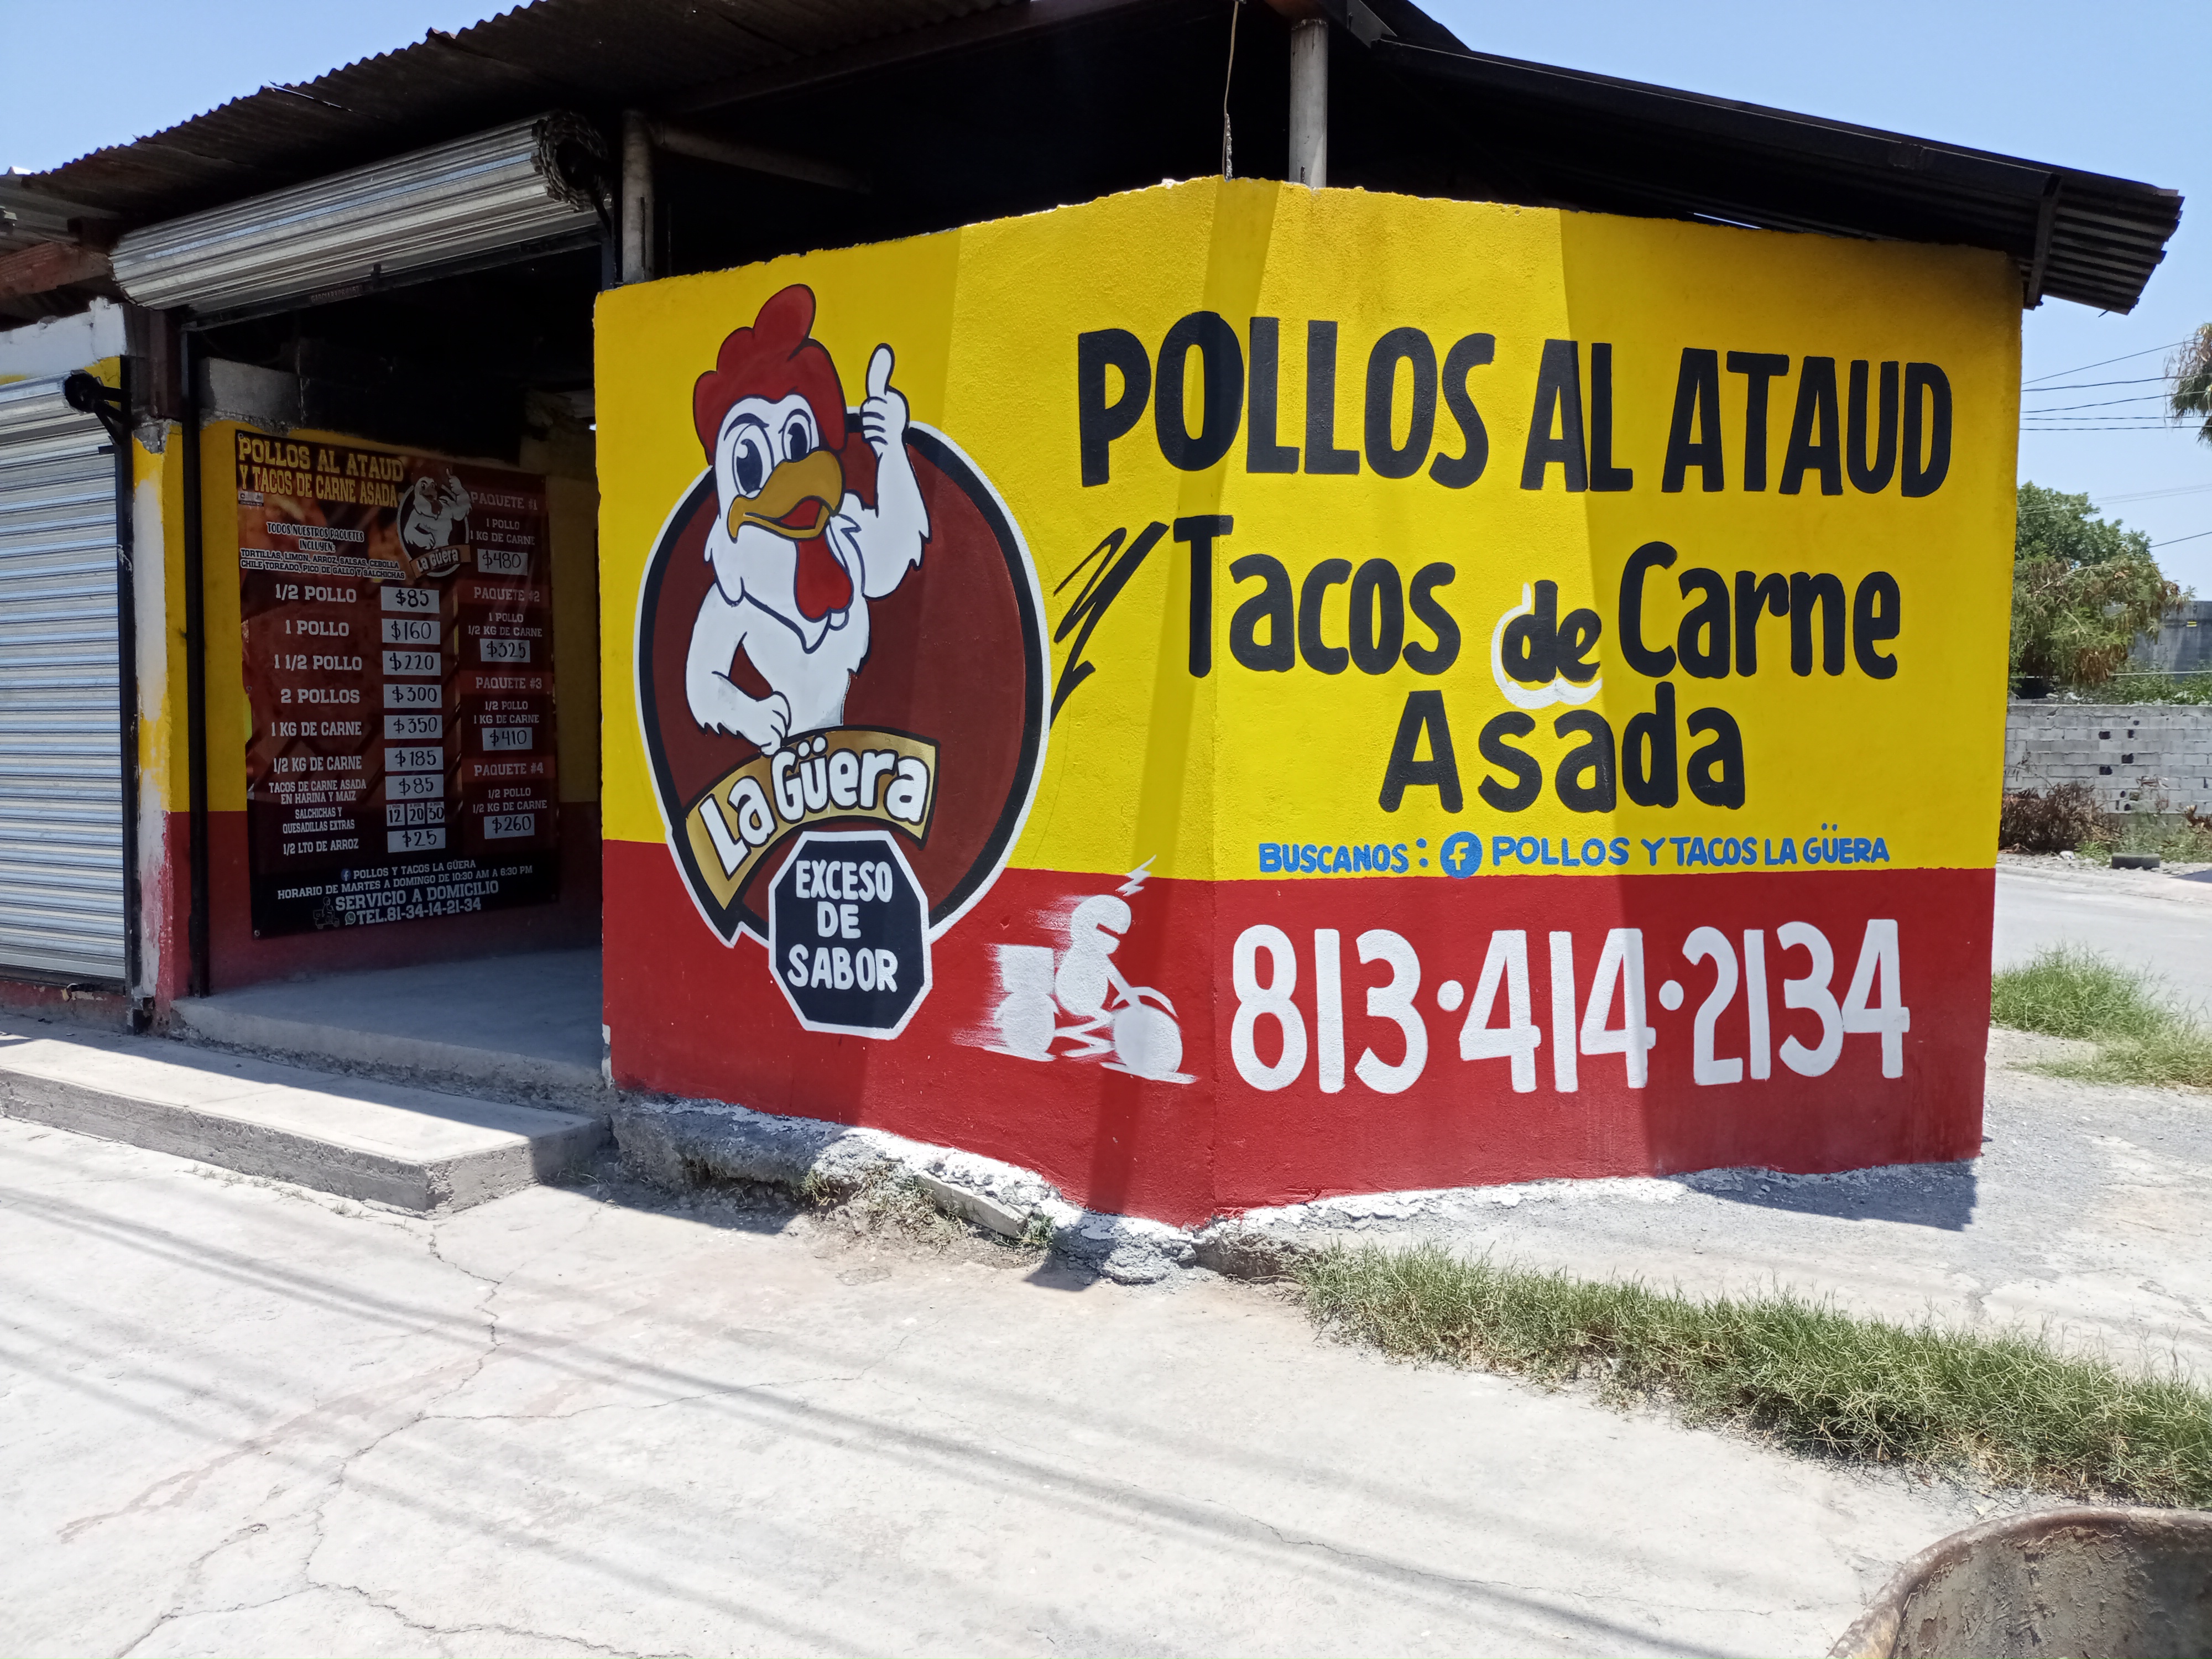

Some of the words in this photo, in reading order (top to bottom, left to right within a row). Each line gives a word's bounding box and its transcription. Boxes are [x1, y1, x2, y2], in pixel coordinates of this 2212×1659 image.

[1078, 310, 1495, 489] POLLOS
[1520, 338, 1633, 493] AL
[1662, 347, 1952, 498] ATAUD
[238, 437, 310, 469] POLLOS
[317, 449, 340, 473] AL
[346, 453, 404, 481] ATAUD
[239, 465, 248, 490] Y
[252, 466, 292, 495] TACOS
[296, 472, 312, 498] DE
[316, 475, 356, 503] CARNE
[359, 481, 398, 508] ASADA
[471, 492, 524, 509] PAQUETE
[528, 498, 538, 510] #1
[267, 523, 291, 534] TODOS
[293, 525, 330, 539] NUESTROS
[330, 528, 364, 542] PAQUETES
[486, 518, 489, 527] 1
[492, 518, 519, 530] POLLO
[300, 540, 335, 552] INCLUYEN:
[471, 530, 473, 539] 1
[476, 531, 488, 541] KG
[492, 533, 503, 542] DE
[506, 534, 535, 545] CARNE
[369, 560, 399, 569] CEBOLLA
[482, 550, 521, 570] $480
[241, 560, 263, 568] CHILE
[363, 569, 405, 580] SALCHICHAS
[276, 584, 298, 601] 1/2
[305, 586, 357, 603] POLLO
[396, 589, 429, 608] $85
[474, 587, 524, 601] PAQUETE
[529, 591, 540, 602] #2
[1173, 514, 1461, 678] Tacos
[1501, 580, 1602, 684] de
[1619, 541, 1901, 680] Carne
[489, 613, 492, 622] 1
[495, 613, 524, 623] POLLO
[286, 619, 291, 634] 1
[297, 620, 349, 637] POLLO
[392, 620, 431, 640] $160
[468, 625, 480, 635] 1/2
[484, 626, 497, 635] KG
[500, 627, 510, 635] DE
[513, 627, 542, 637] CARNE
[487, 640, 525, 658] $325
[274, 654, 280, 669] 1
[285, 655, 307, 671] 1/2
[313, 655, 362, 671] POLLO
[389, 653, 434, 671] $220
[476, 677, 525, 688] PAQUETE
[530, 677, 542, 689] #3
[281, 688, 291, 703] 2
[298, 688, 360, 703] POLLOS
[392, 686, 437, 702] $300
[485, 701, 498, 711] 1/2
[502, 701, 528, 710] POLLO
[394, 717, 437, 734] $350
[474, 715, 476, 724] 1
[479, 715, 493, 724] KG
[496, 714, 507, 724] DE
[509, 714, 539, 723] CARNE
[272, 722, 276, 737] 1
[280, 722, 297, 737] KG
[301, 722, 317, 736] DE
[321, 721, 362, 735] CARNE
[489, 729, 526, 746] $410
[1379, 681, 1745, 813] Asada
[274, 758, 288, 774] 1/2
[292, 757, 306, 771] KG
[310, 757, 324, 771] DE
[327, 756, 362, 770] CARNE
[395, 750, 436, 767] $185
[474, 764, 526, 776] PAQUETE
[531, 762, 544, 774] #4
[269, 782, 295, 793] TACOS
[298, 781, 309, 791] DE
[311, 780, 338, 791] CARNE
[340, 779, 367, 790] ASADA
[399, 777, 433, 796] $85
[488, 789, 500, 799] 1/2
[503, 787, 531, 797] POLLO
[281, 793, 293, 805] EN
[295, 792, 326, 804] HARINA
[328, 791, 335, 802] Y
[336, 791, 356, 801] MAIZ
[699, 776, 775, 880] La
[771, 733, 927, 824] Güera
[295, 807, 336, 820] SALCHICHAS
[337, 807, 342, 817] Y
[409, 808, 424, 821] 20
[427, 807, 444, 820] 30
[473, 804, 484, 814] 1/2
[487, 802, 500, 812] KG
[503, 801, 514, 811] DE
[517, 800, 547, 810] CARNE
[389, 809, 402, 823] 12
[492, 816, 531, 833] $260
[283, 821, 327, 834] QUESADILLAS
[330, 820, 354, 830] EXTRAS
[283, 843, 295, 856] 1/2
[298, 842, 314, 854] LTO
[316, 841, 327, 852] DE
[330, 838, 359, 851] ARROZ
[403, 830, 437, 847] $25
[1493, 836, 1630, 866] POLLOS
[1641, 837, 1665, 865] Y
[1669, 837, 1757, 867] TACOS
[1765, 838, 1797, 865] LA
[1803, 823, 1890, 864] GÜERA
[353, 868, 389, 879] POLLOS
[392, 867, 398, 876] Y
[400, 863, 430, 875] TACOS
[432, 863, 444, 873] LA
[446, 859, 476, 871] GÜERA
[277, 886, 322, 900] HORARIO
[325, 885, 338, 894] DE
[341, 881, 380, 893] MARTES
[384, 880, 391, 889] A
[393, 874, 436, 888] DOMINGO
[439, 874, 450, 883] DE
[452, 872, 473, 881] 10:30
[476, 870, 489, 879] AM
[492, 868, 498, 877] A
[500, 867, 518, 876] 6:30
[520, 865, 533, 875] PM
[796, 859, 893, 902] EXCESO
[336, 890, 406, 911] SERVICIO
[411, 889, 422, 903] A
[427, 880, 499, 901] DOMICILIO
[817, 901, 862, 939] DE
[787, 943, 898, 992] SABOR
